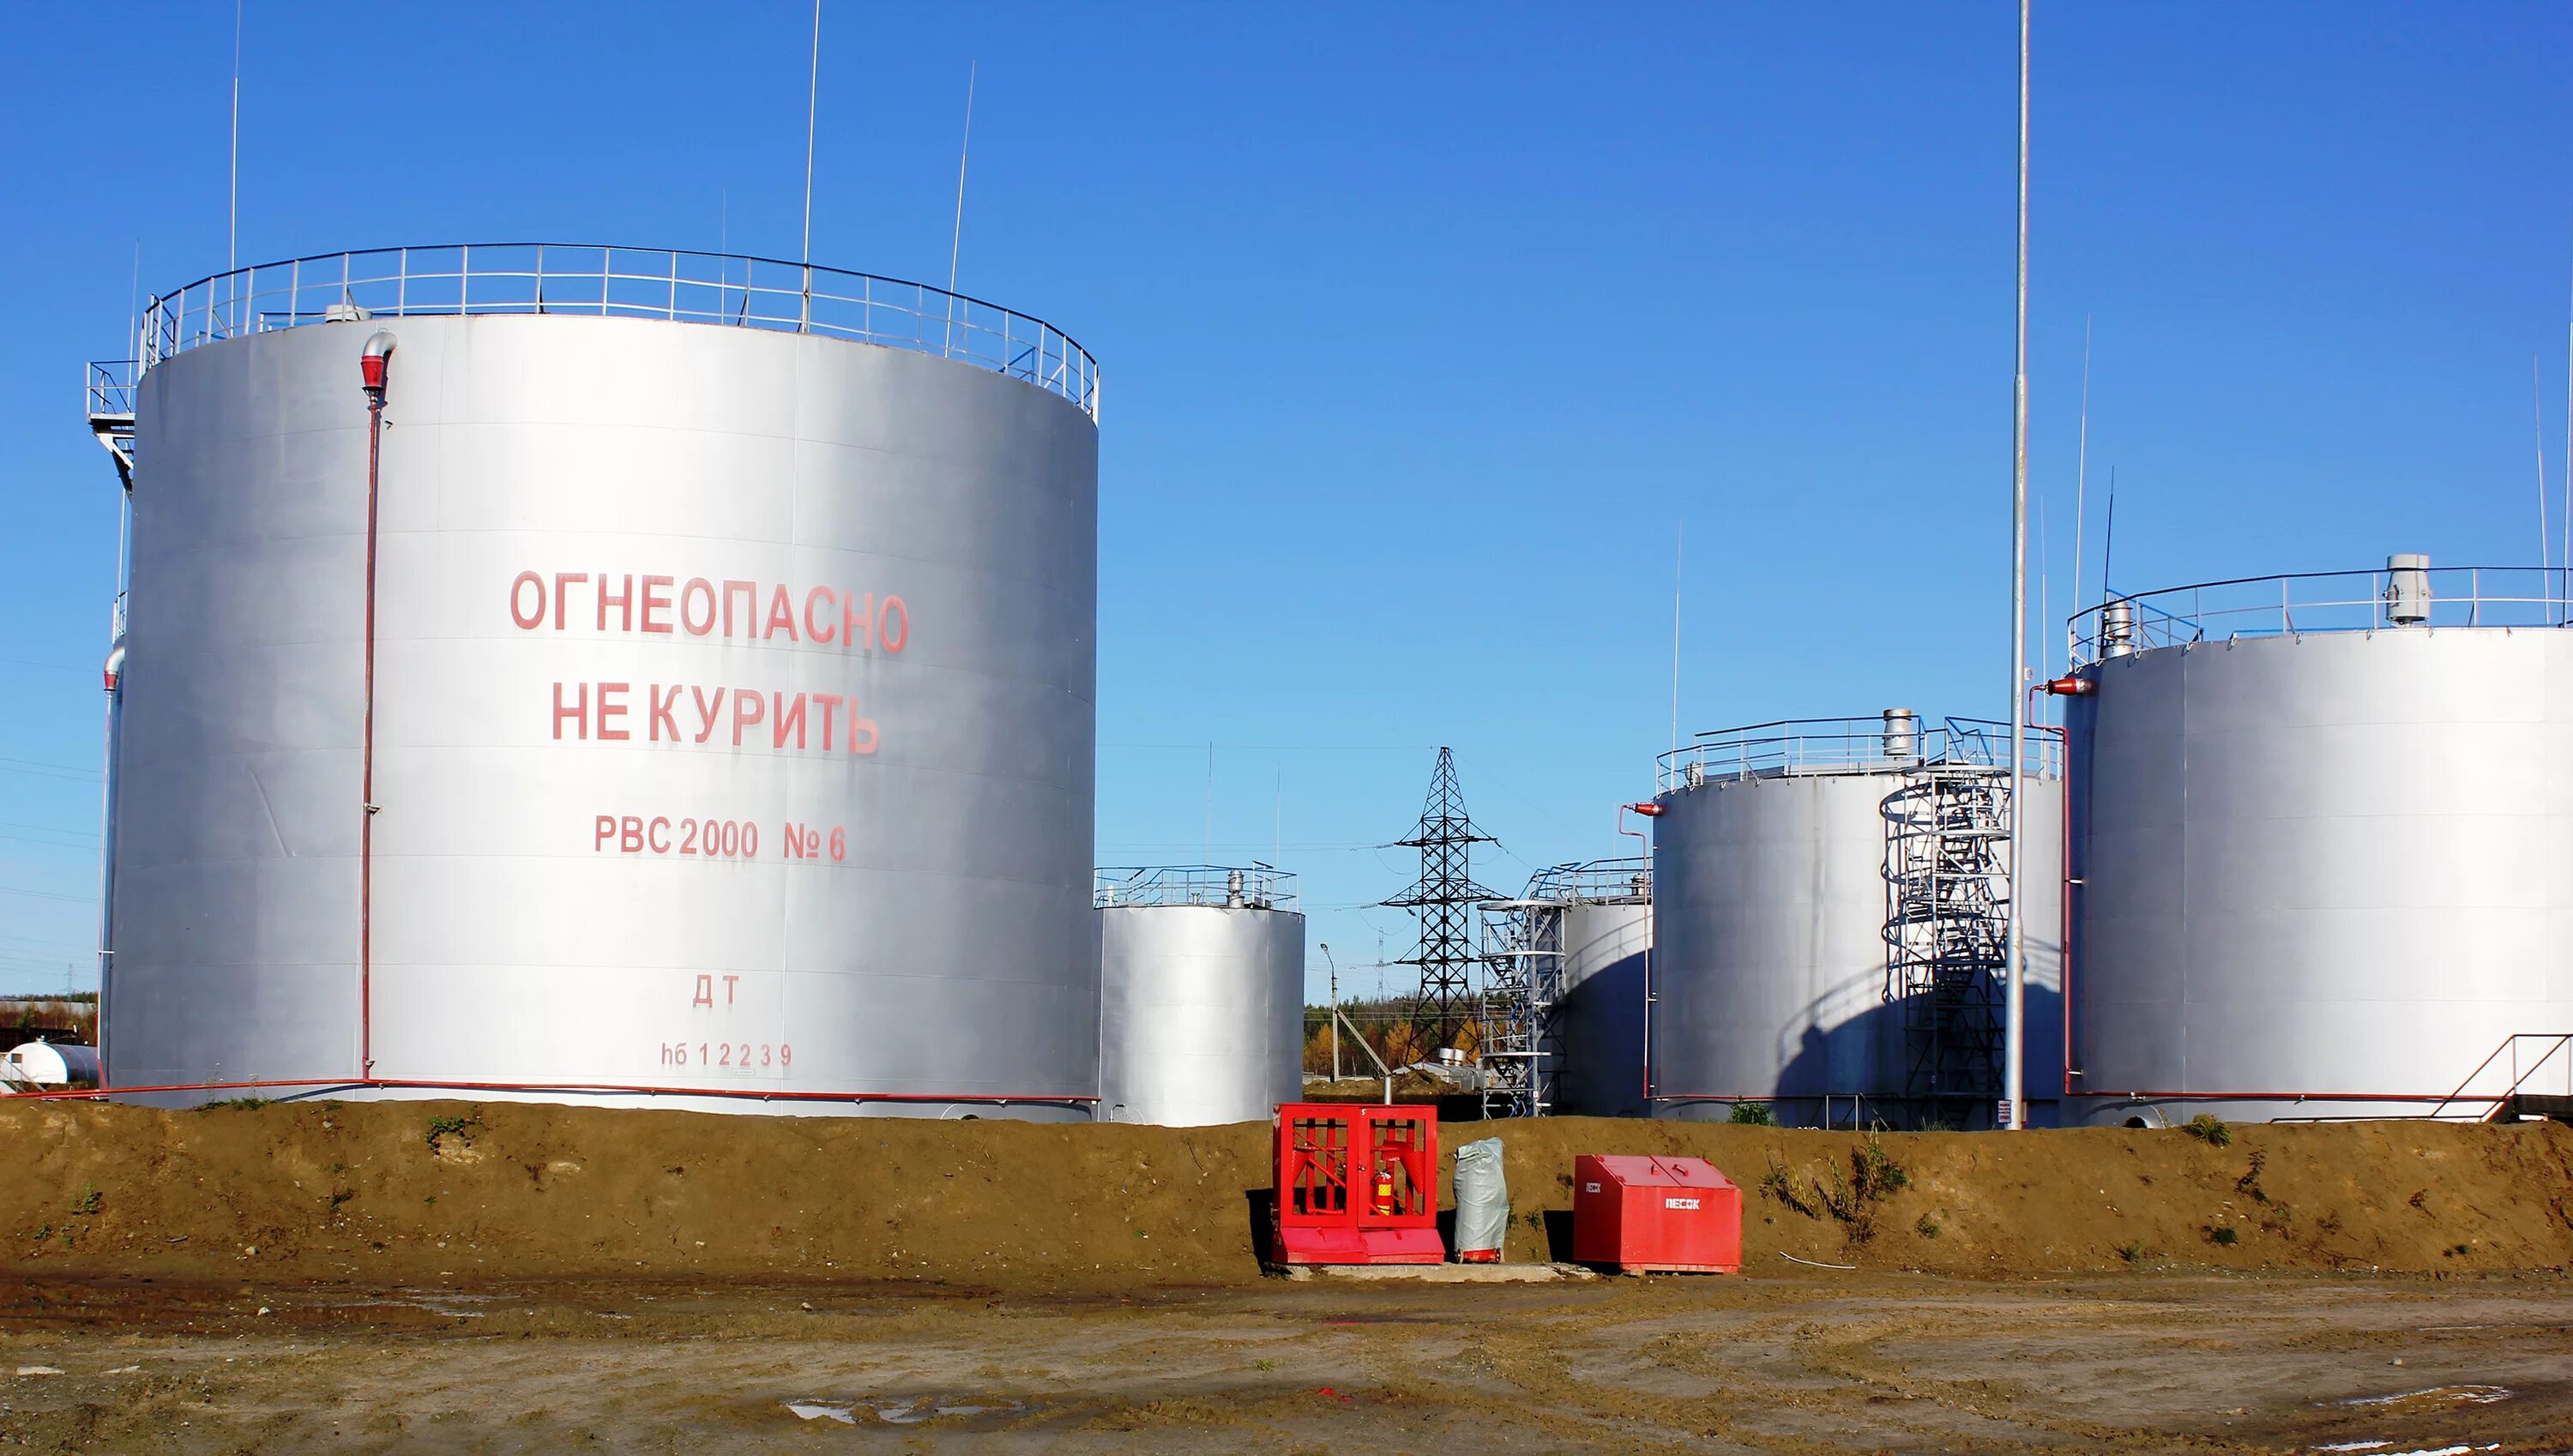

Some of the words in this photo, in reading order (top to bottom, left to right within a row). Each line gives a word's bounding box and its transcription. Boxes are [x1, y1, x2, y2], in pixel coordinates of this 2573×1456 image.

[509, 569, 909, 654] ОГНЕОПАСНО
[552, 683, 630, 741] НЕ
[648, 684, 880, 755] КУРИТЬ
[1666, 1198, 1700, 1210] ПЕСОК
